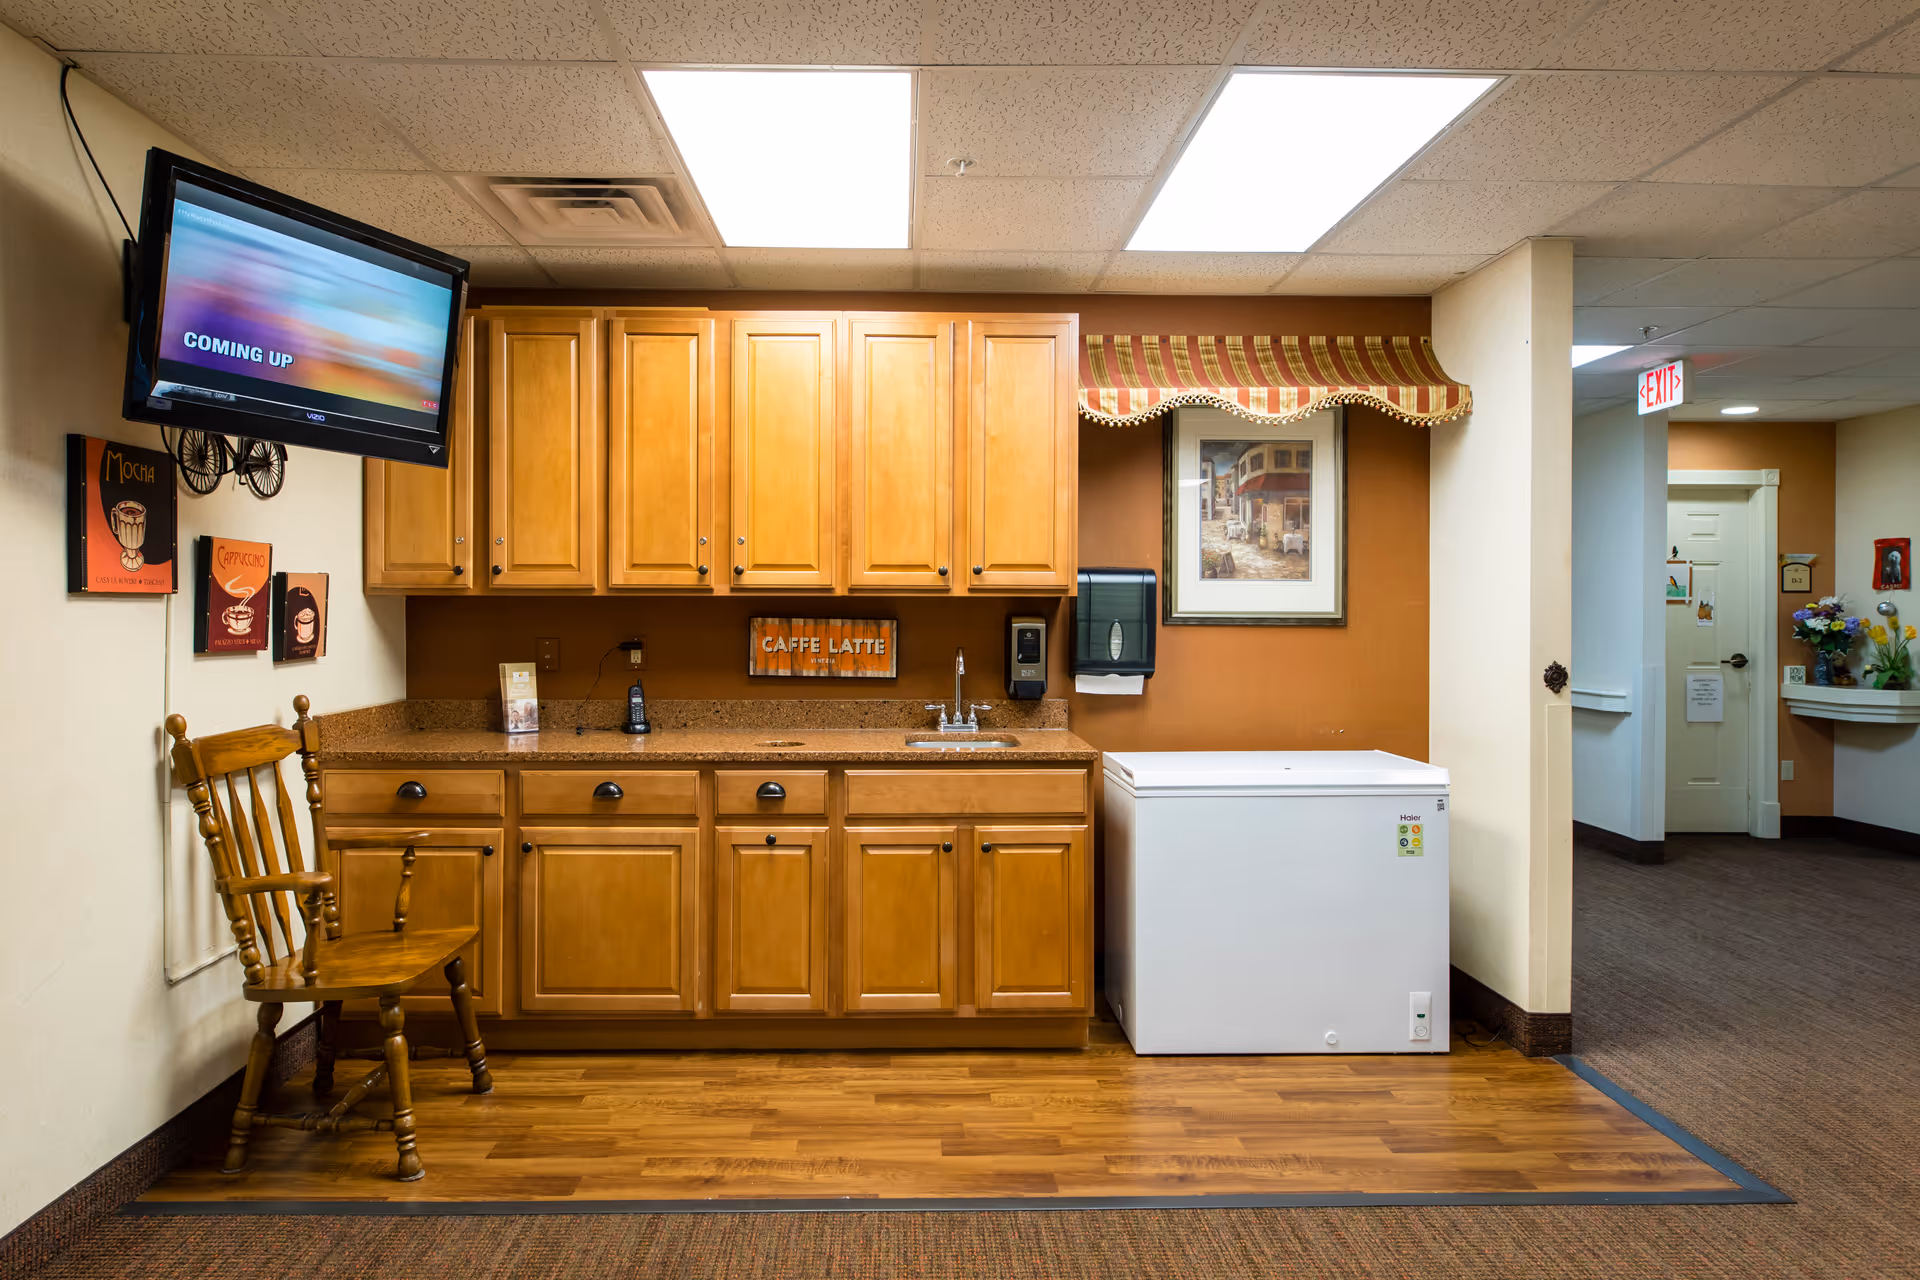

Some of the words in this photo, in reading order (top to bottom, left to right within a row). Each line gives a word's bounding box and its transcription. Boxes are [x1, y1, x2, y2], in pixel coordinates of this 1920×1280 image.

[183, 331, 264, 364] COMING
[268, 350, 294, 369] UP
[1646, 364, 1676, 408] EXIT
[306, 412, 325, 422] VIZIO
[106, 449, 155, 484] MOCHA
[217, 545, 266, 570] CAPPUCCINO
[761, 635, 821, 653] CAFFE
[828, 637, 886, 655] LATTE
